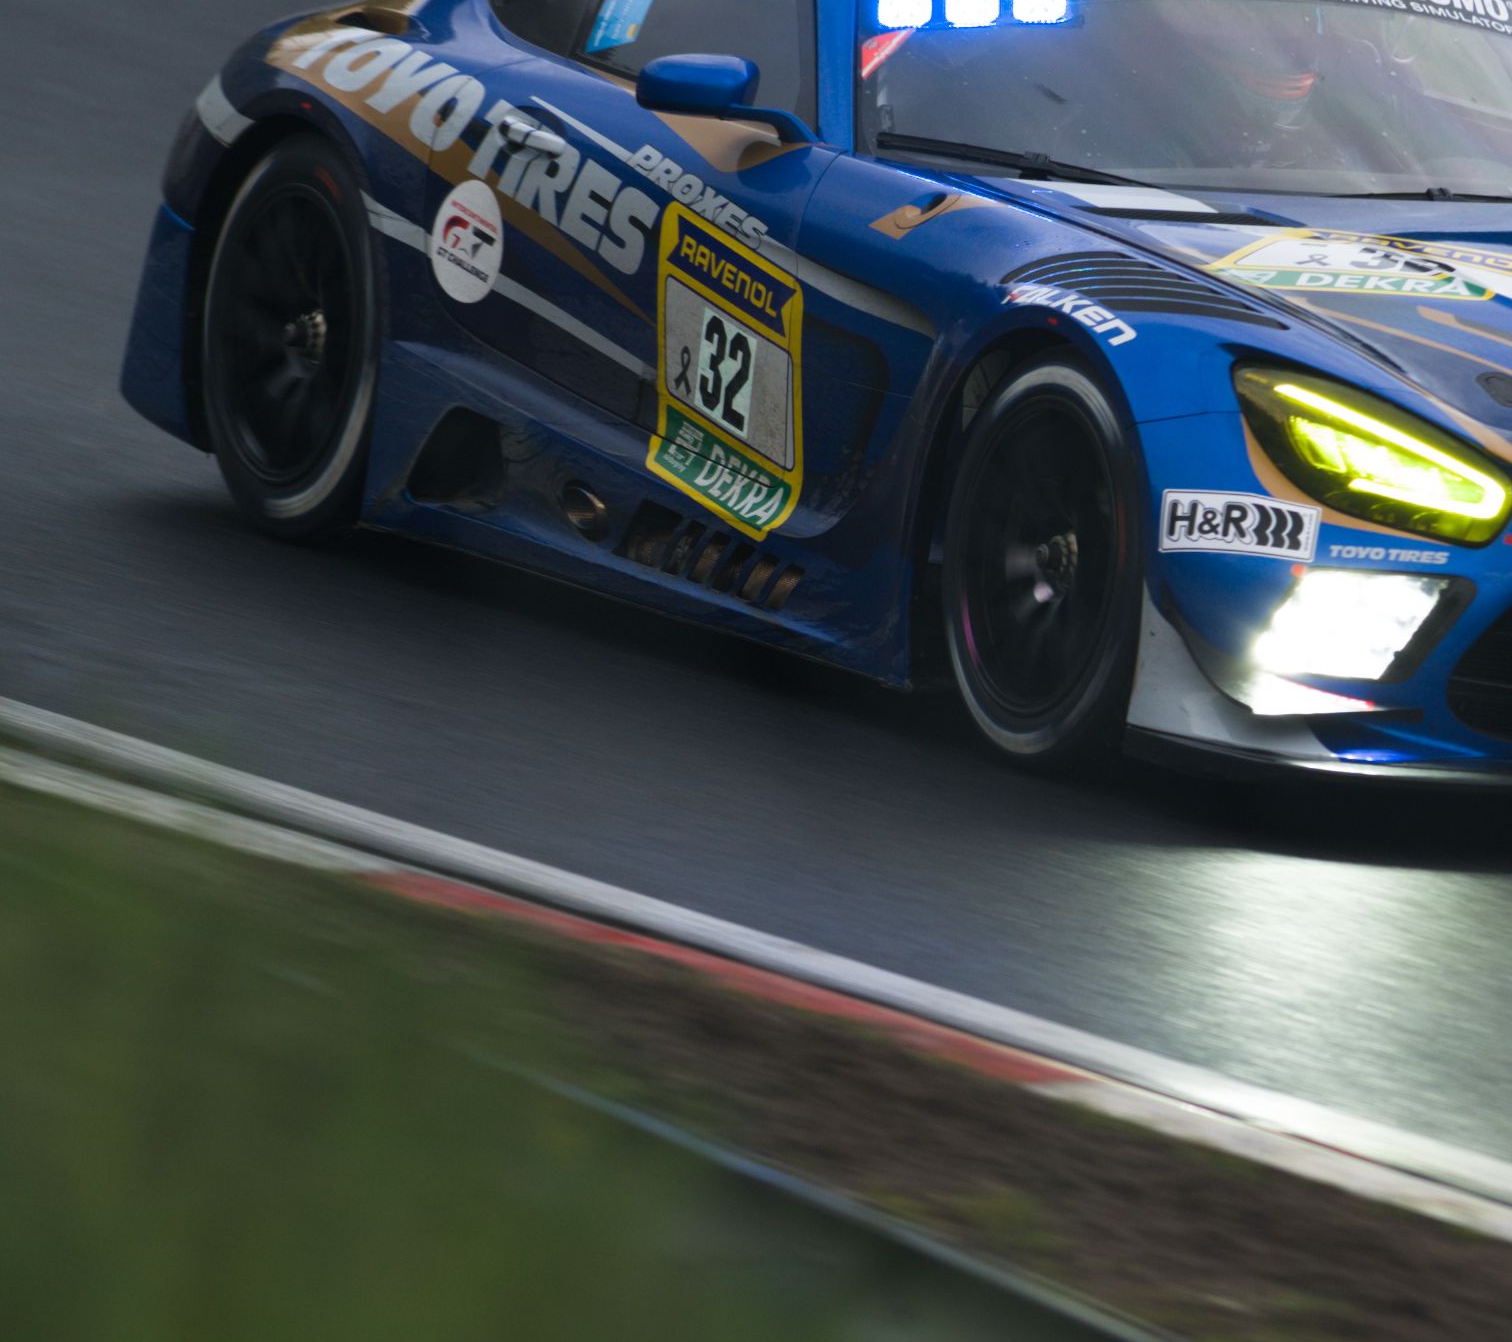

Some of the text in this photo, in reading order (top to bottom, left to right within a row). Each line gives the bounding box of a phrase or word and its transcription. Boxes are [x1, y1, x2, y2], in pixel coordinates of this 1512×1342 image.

[293, 26, 486, 152] TOYO
[627, 144, 769, 251] PROXES
[680, 235, 777, 318] RAVENOL
[1296, 272, 1471, 296] DEKRA
[699, 315, 751, 433] 32
[694, 444, 785, 525] DEKRA
[1166, 500, 1250, 541] H&R
[1330, 545, 1449, 564] TOYO TIRES
